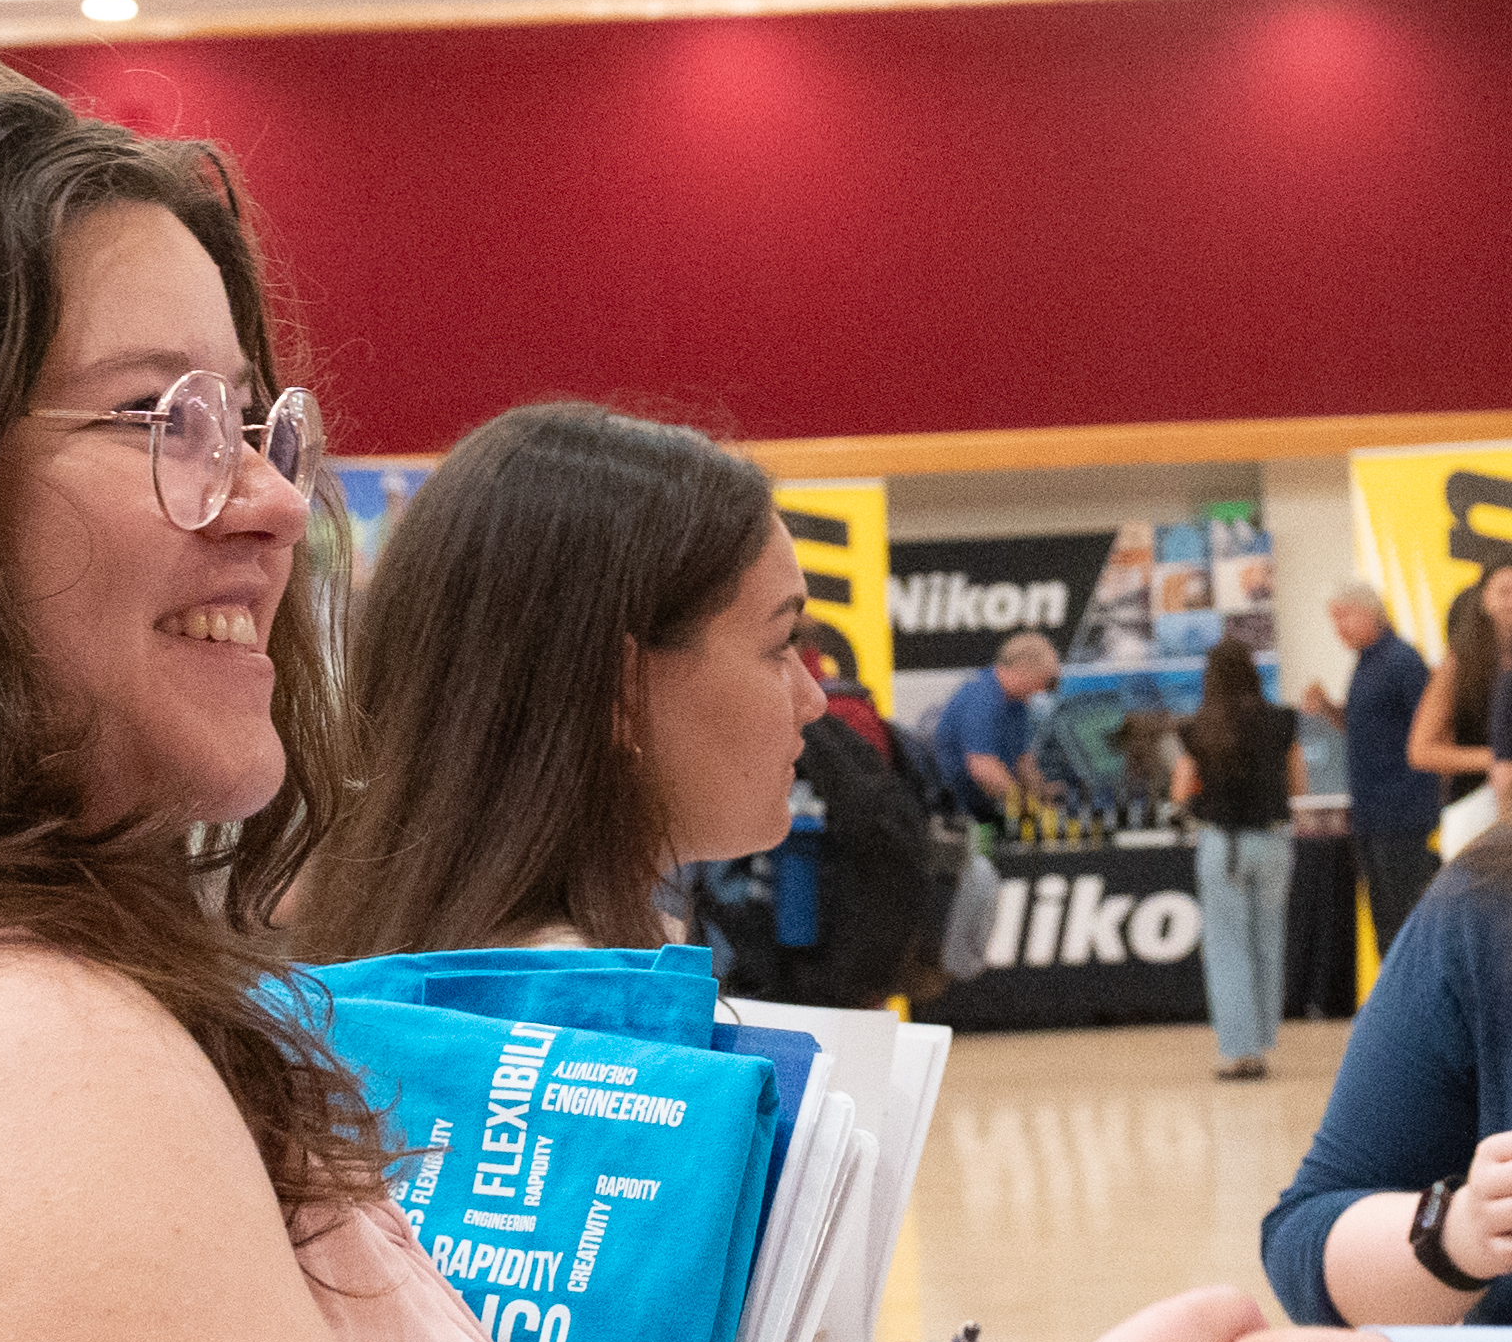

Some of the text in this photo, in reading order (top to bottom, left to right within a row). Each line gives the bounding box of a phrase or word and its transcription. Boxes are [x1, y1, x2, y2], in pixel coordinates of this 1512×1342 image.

[886, 571, 1068, 633] Nikon
[552, 1060, 638, 1086] CREATIVITY
[541, 1082, 687, 1128] ENGINEERING
[523, 1135, 554, 1207] RAPIDITY
[595, 1175, 661, 1201] RAPIDITY
[463, 1209, 537, 1233] ENGINEERING
[567, 1200, 612, 1293] CREATIVITY
[432, 1234, 564, 1292] RAPIDITY
